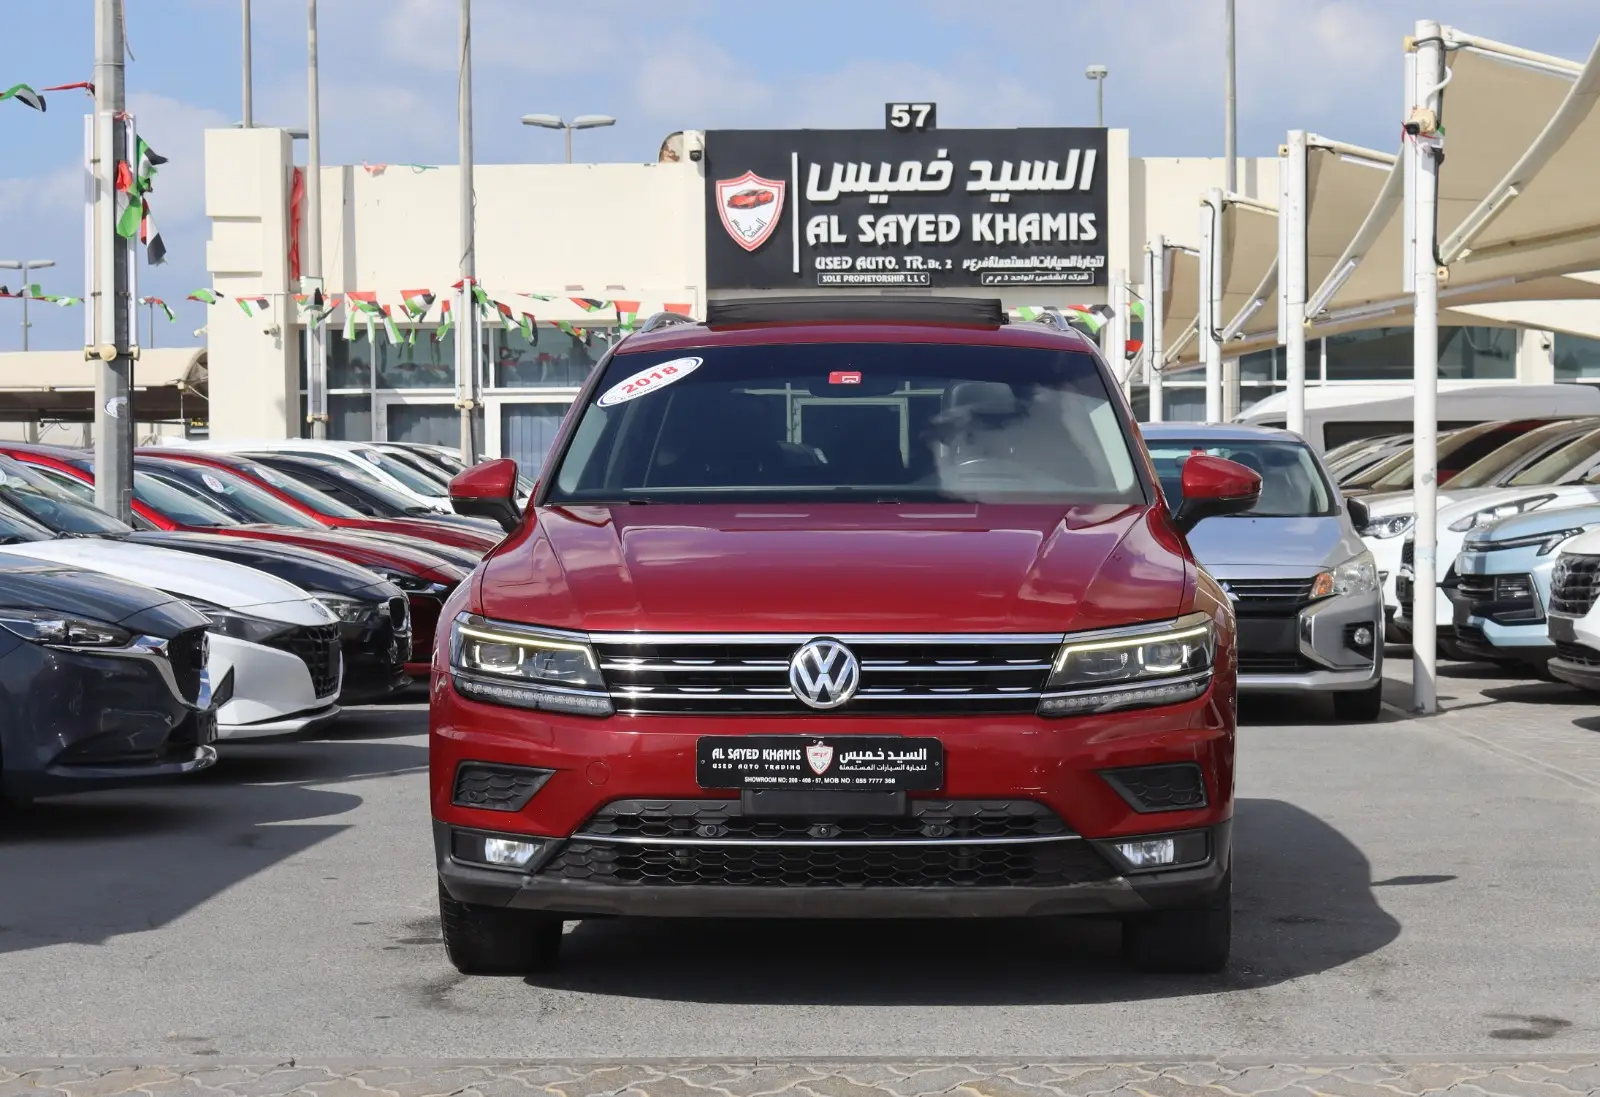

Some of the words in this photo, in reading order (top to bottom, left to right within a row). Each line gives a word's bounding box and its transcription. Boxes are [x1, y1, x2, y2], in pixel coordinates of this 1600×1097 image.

[891, 104, 931, 127] 57
[806, 149, 953, 203] خميس
[966, 149, 1097, 202] السيد
[806, 215, 847, 247] AL
[858, 213, 960, 246] SAYED
[972, 212, 1097, 245] KHAMIS
[815, 256, 852, 269] USED
[856, 256, 899, 270] AUTO.
[945, 259, 952, 269] 2
[621, 366, 678, 394] 2018
[712, 748, 725, 760] AL
[728, 748, 759, 760] SAYED
[763, 749, 801, 761] KHAMIS
[839, 747, 885, 763] خميس
[887, 748, 927, 763] السيد
